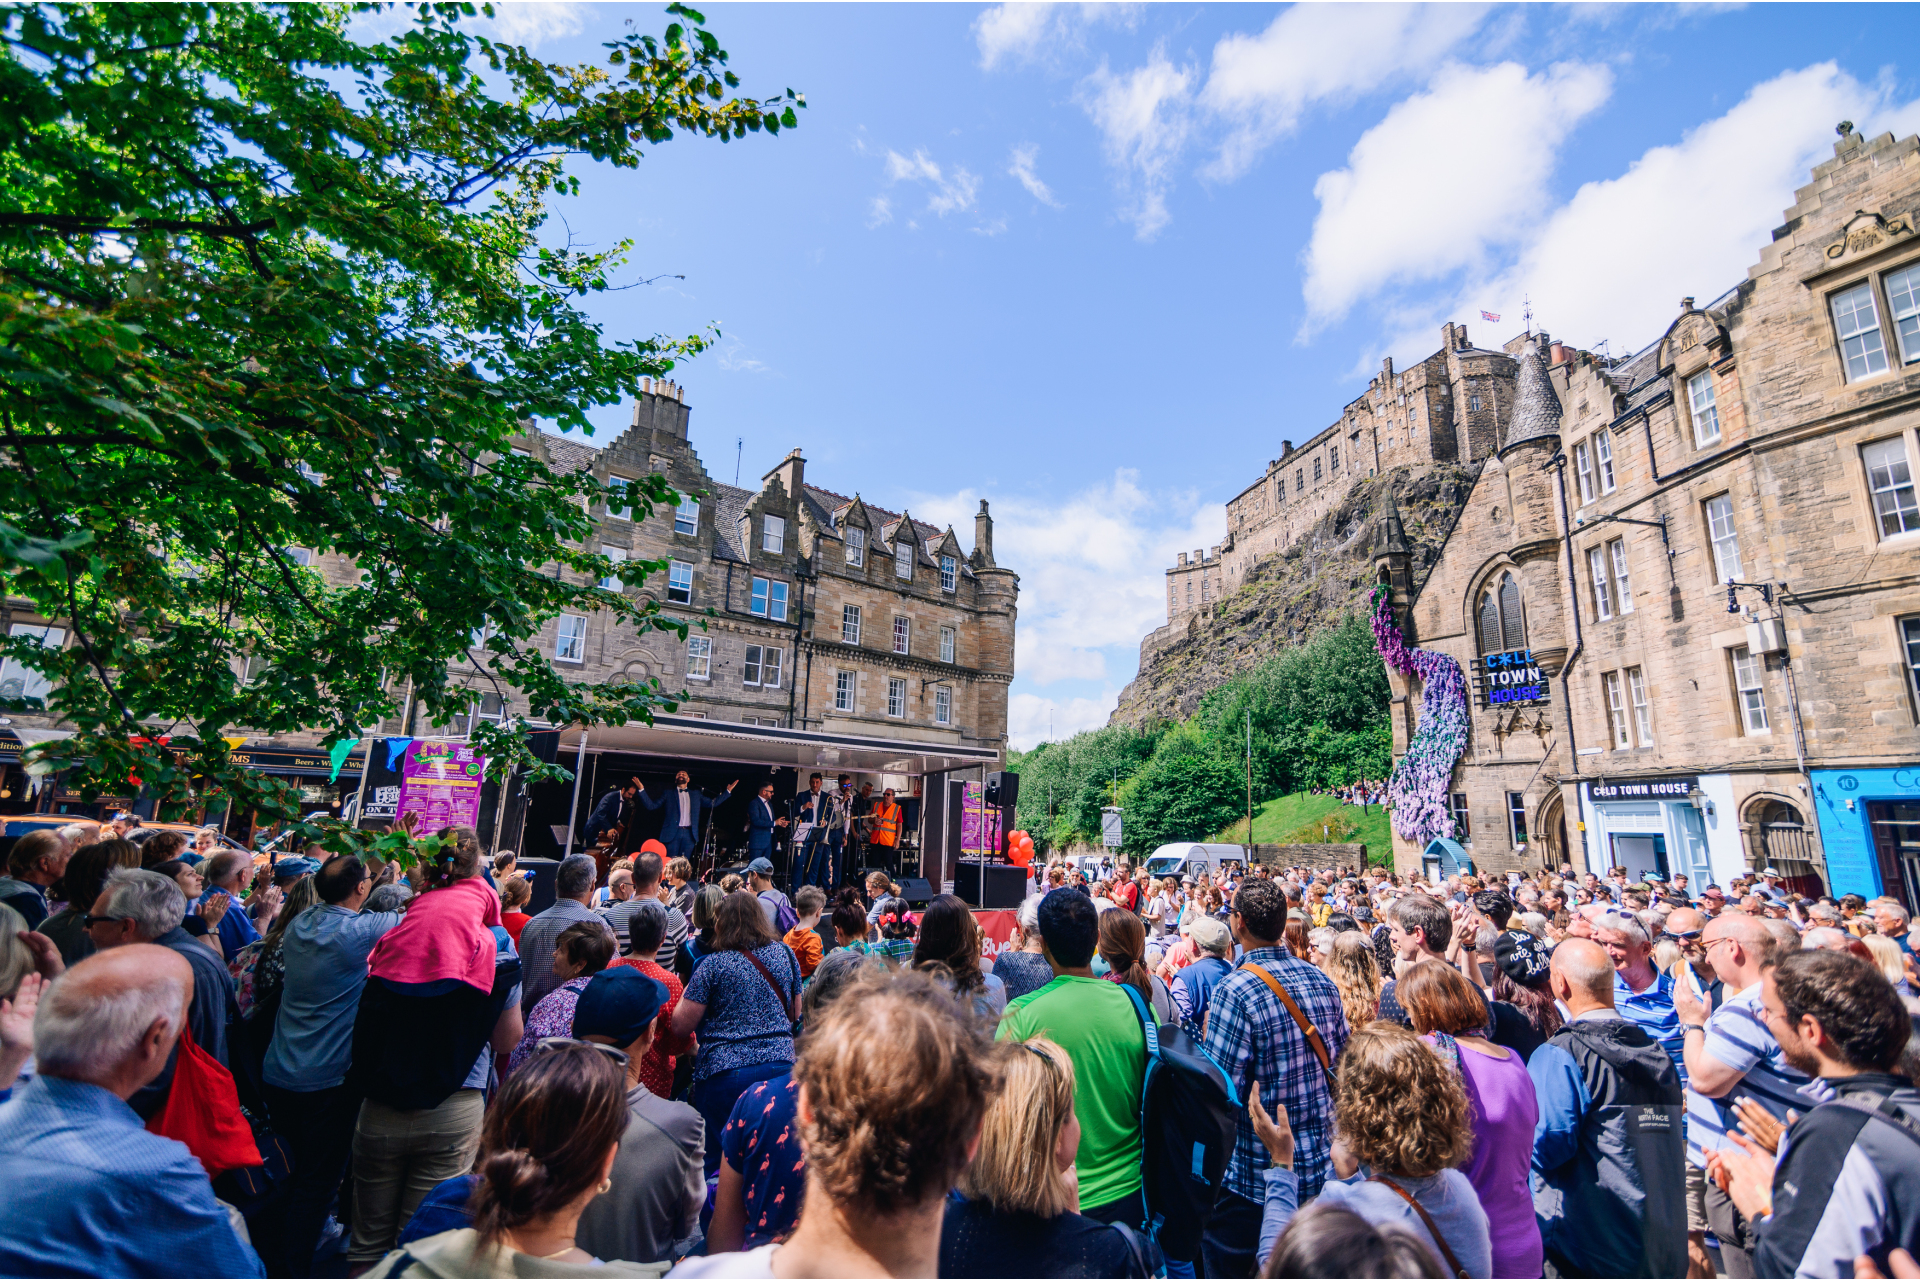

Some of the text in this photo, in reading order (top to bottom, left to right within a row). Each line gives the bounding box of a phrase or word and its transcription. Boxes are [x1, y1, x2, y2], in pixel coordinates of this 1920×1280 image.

[1488, 667, 1541, 686] TOWN
[1488, 686, 1542, 704] HOUSE
[295, 758, 314, 766] Beers
[1619, 784, 1648, 796] TOWN
[1651, 782, 1688, 795] HOUSE
[1839, 778, 1855, 789] 10
[1509, 931, 1531, 944] la
[1509, 945, 1532, 962] vie
